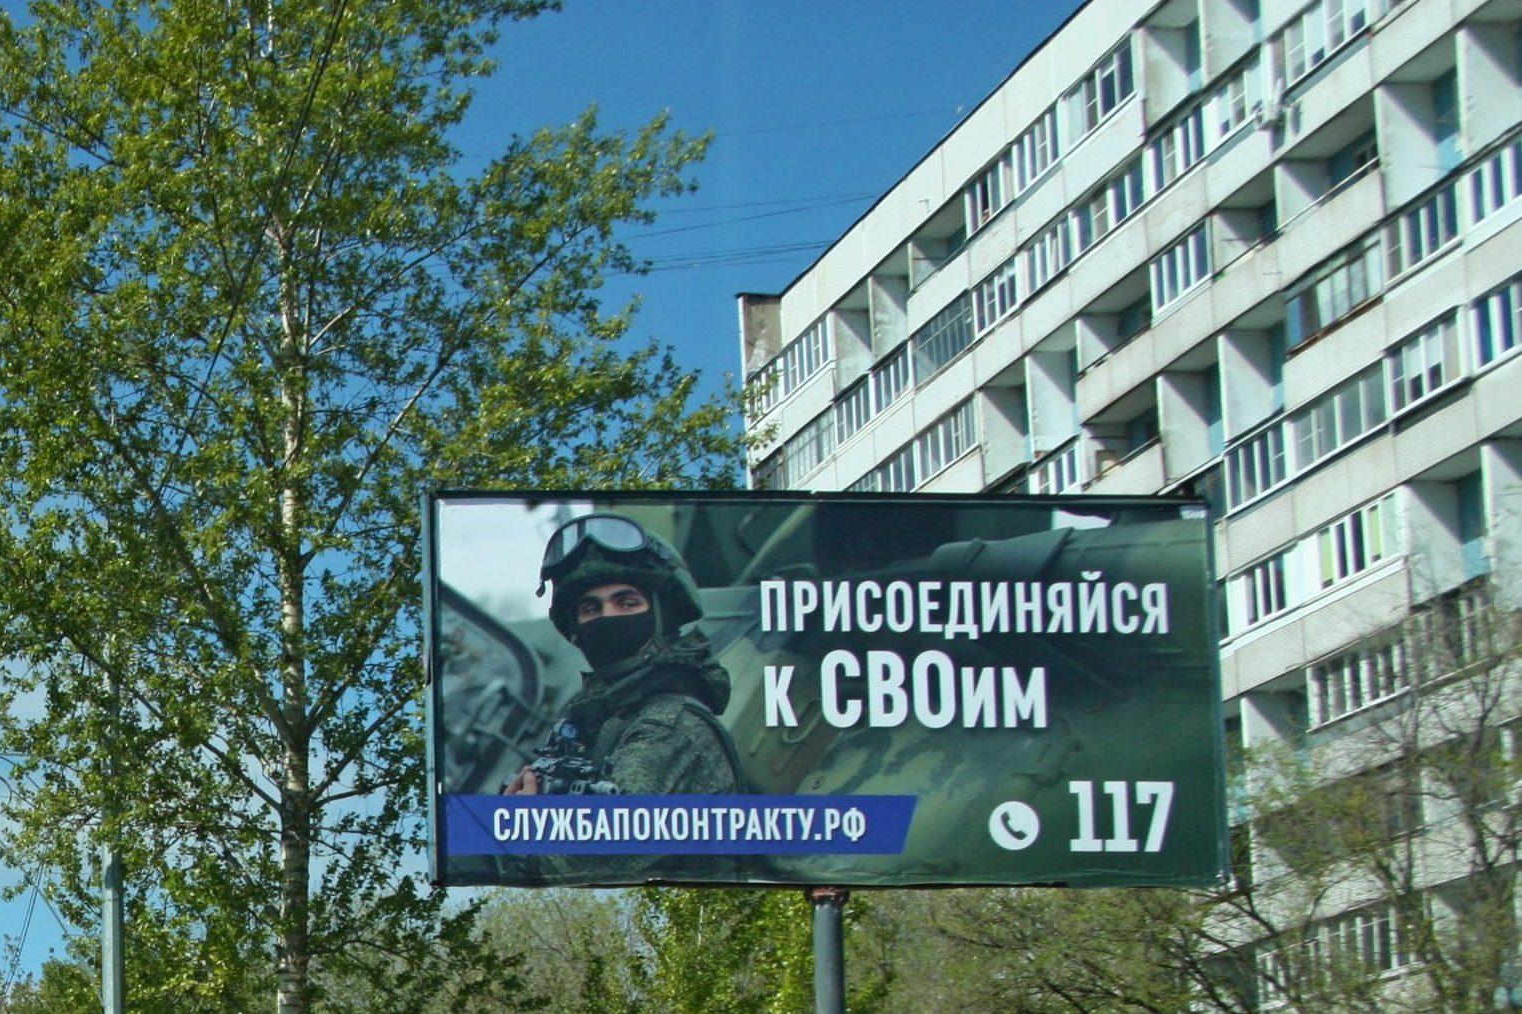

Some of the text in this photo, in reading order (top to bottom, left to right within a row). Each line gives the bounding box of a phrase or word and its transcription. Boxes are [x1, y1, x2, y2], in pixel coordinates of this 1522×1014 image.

[760, 570, 1169, 640] ПРИСОЕДИНЯЙСЯ
[493, 807, 867, 842] СЛУЖБАПОКОНТРАКТУ.РФ
[1068, 780, 1175, 853] 117
